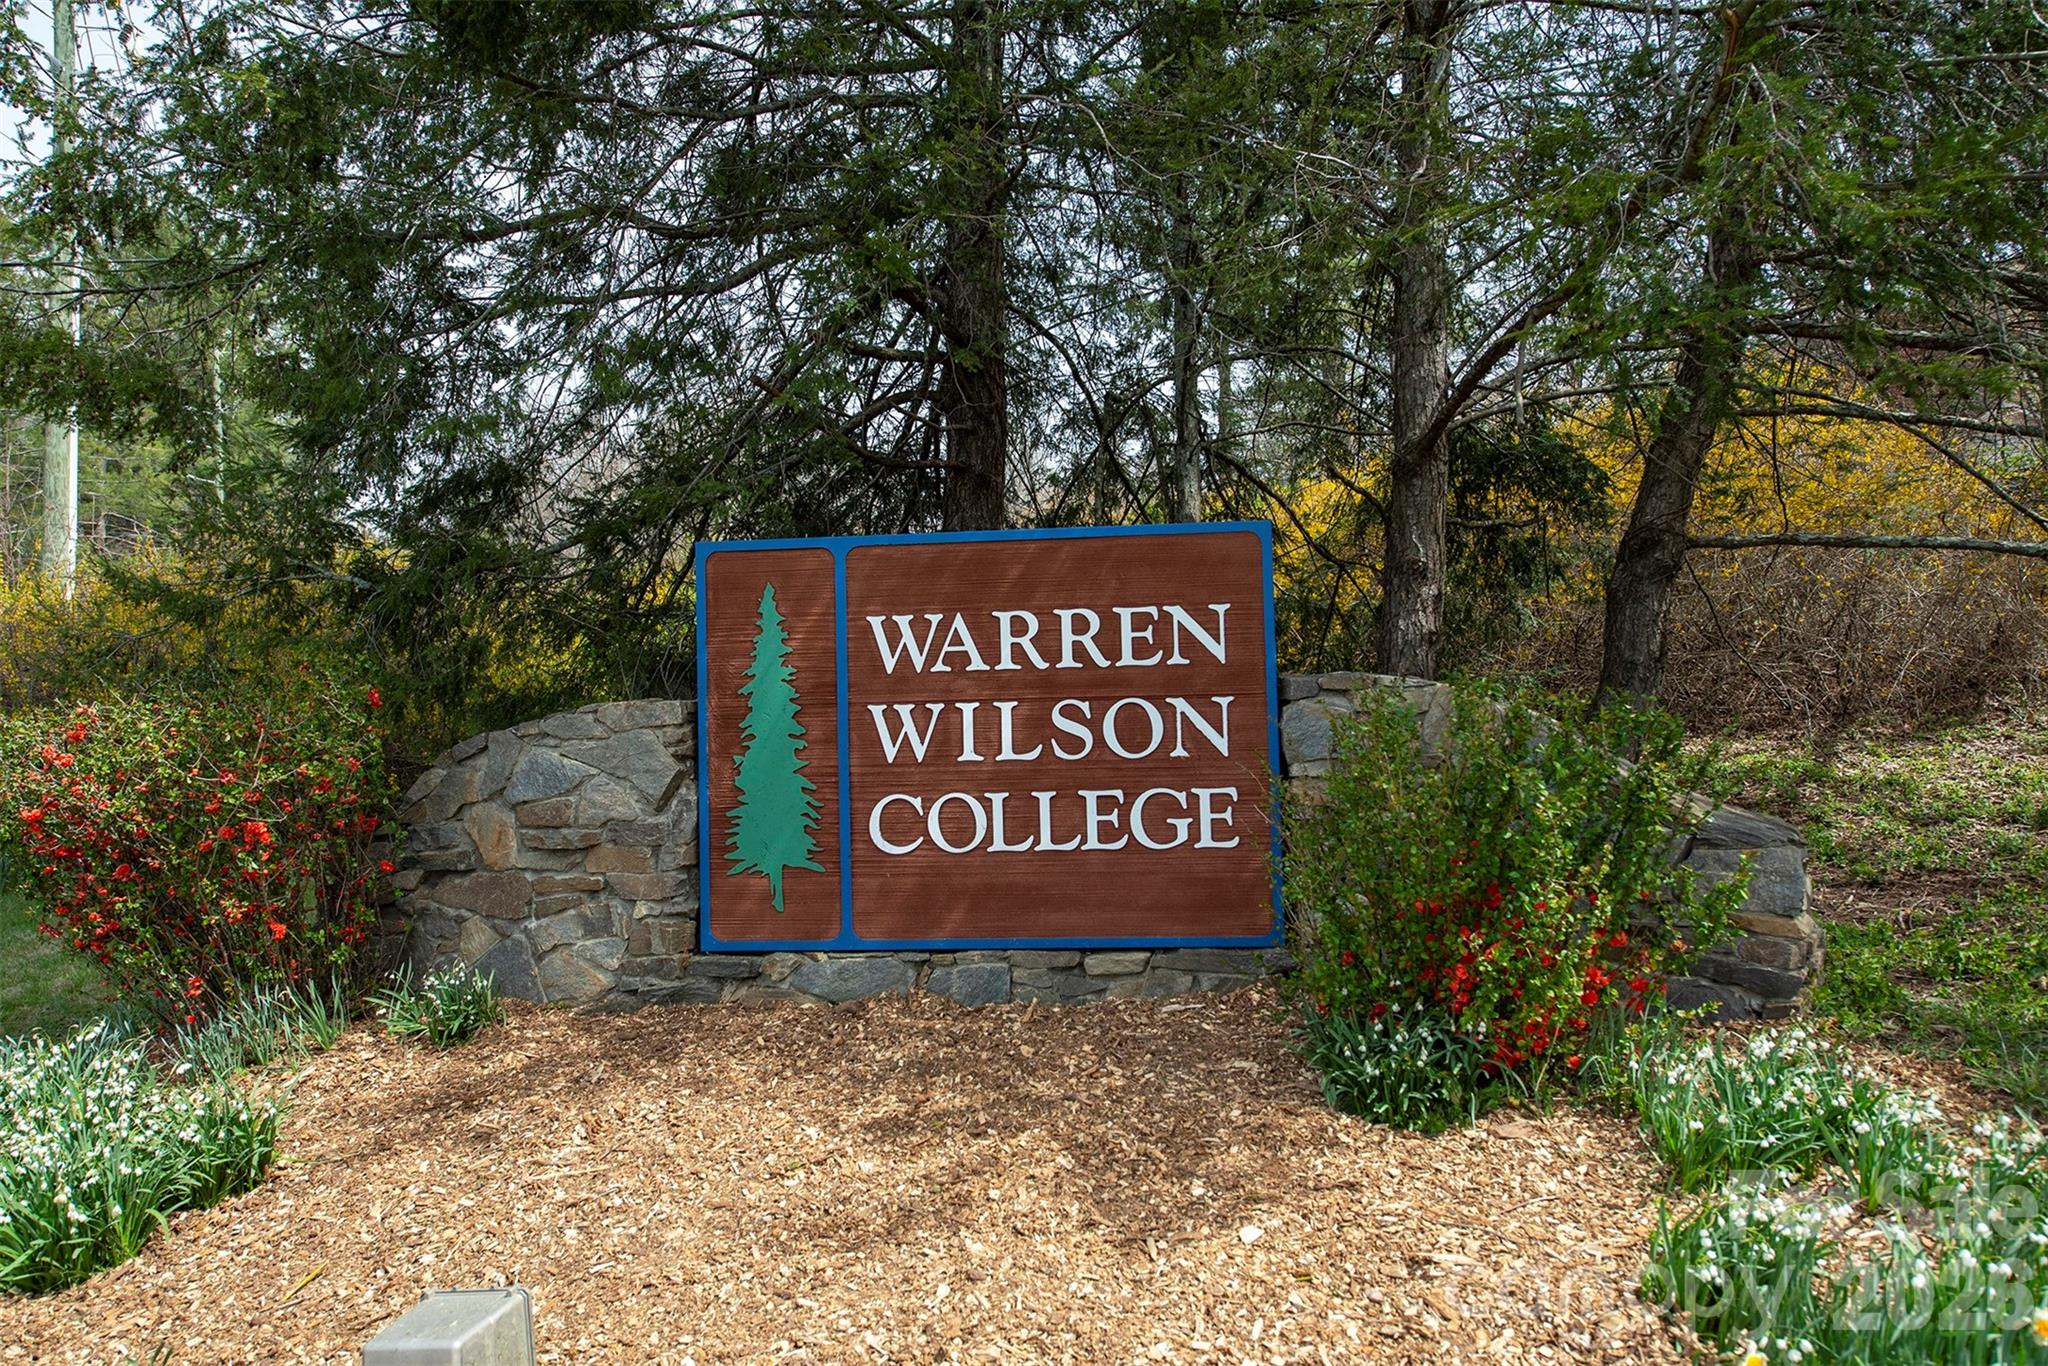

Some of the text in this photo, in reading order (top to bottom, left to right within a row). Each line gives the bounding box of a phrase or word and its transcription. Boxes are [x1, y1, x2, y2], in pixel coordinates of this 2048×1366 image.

[866, 603, 1232, 675] WARREN
[867, 695, 1235, 764] WILSON
[868, 786, 1240, 855] COLLEGE
